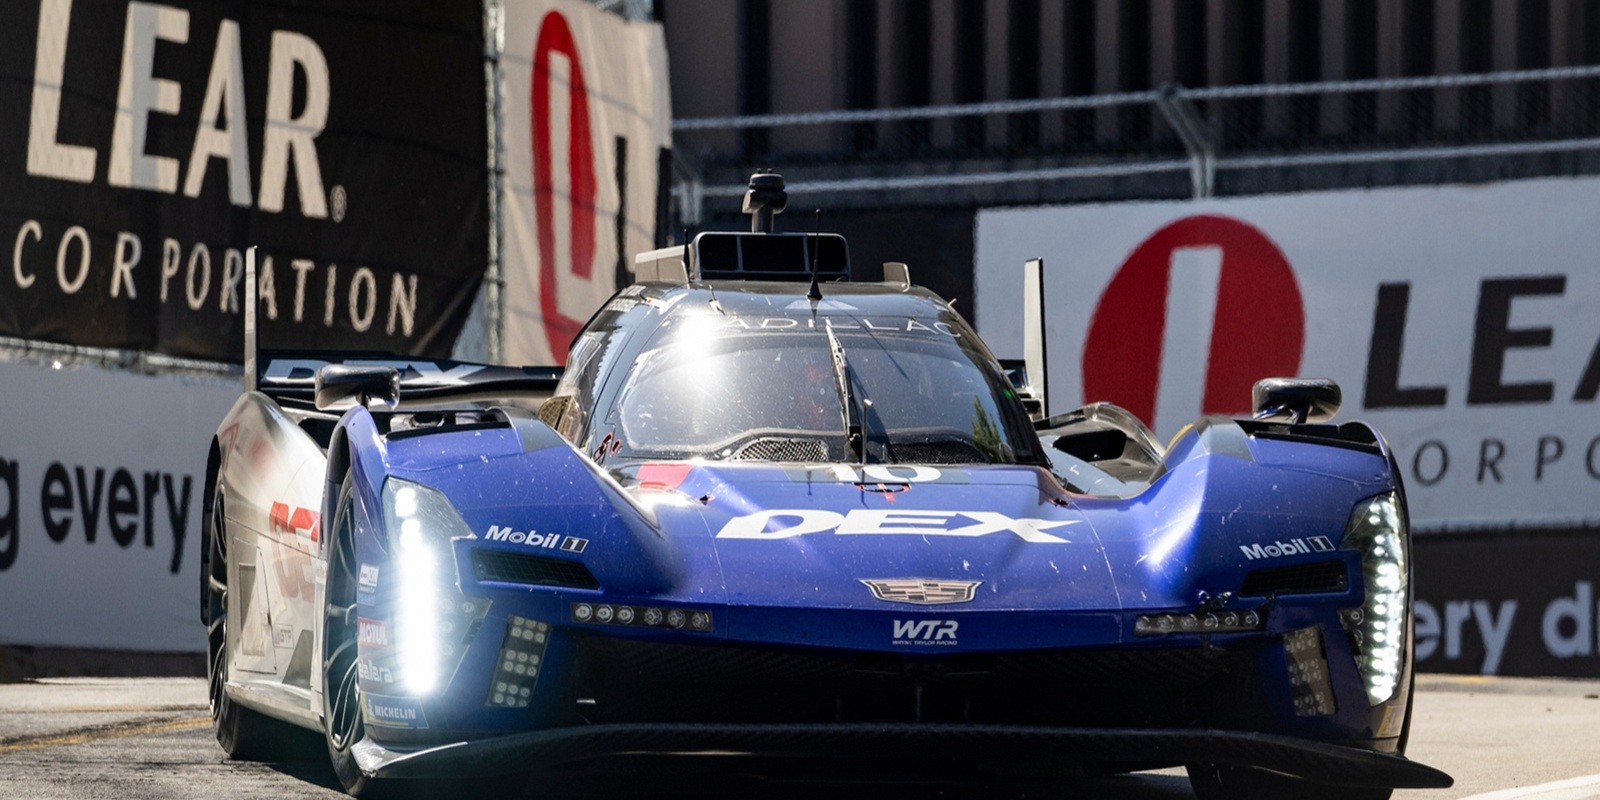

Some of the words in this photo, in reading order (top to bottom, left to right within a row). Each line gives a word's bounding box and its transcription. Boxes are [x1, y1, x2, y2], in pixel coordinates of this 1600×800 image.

[27, 0, 330, 218] LEAR
[13, 219, 418, 337] CORPORATION
[715, 314, 962, 338] ADILLAC
[41, 461, 192, 575] every
[715, 508, 1086, 544] DEX
[485, 525, 560, 549] Mobil
[1240, 538, 1311, 560] Mobil
[359, 622, 389, 646] MOTUL
[893, 620, 959, 640] WTR
[374, 704, 416, 720] MICHELIN
